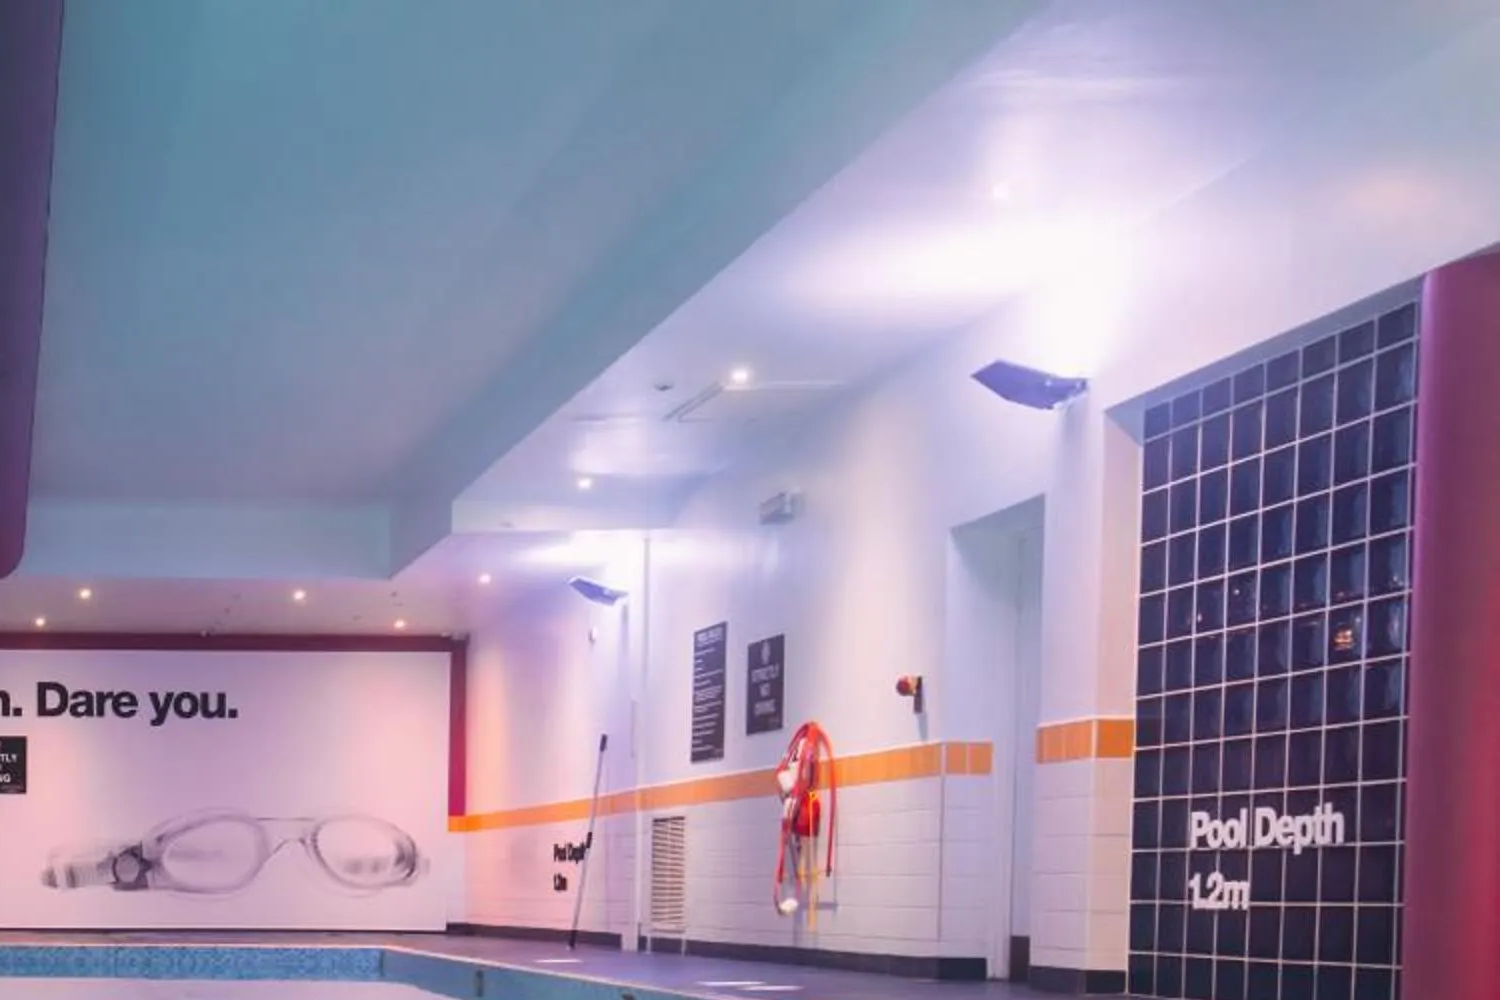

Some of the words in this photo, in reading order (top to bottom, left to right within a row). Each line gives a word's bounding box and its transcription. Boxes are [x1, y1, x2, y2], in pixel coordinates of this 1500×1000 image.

[36, 681, 139, 718] Dare
[149, 690, 239, 726] you.
[1190, 807, 1248, 849] Pool
[1254, 802, 1345, 855] Depth
[1189, 871, 1249, 910] 1.2m
